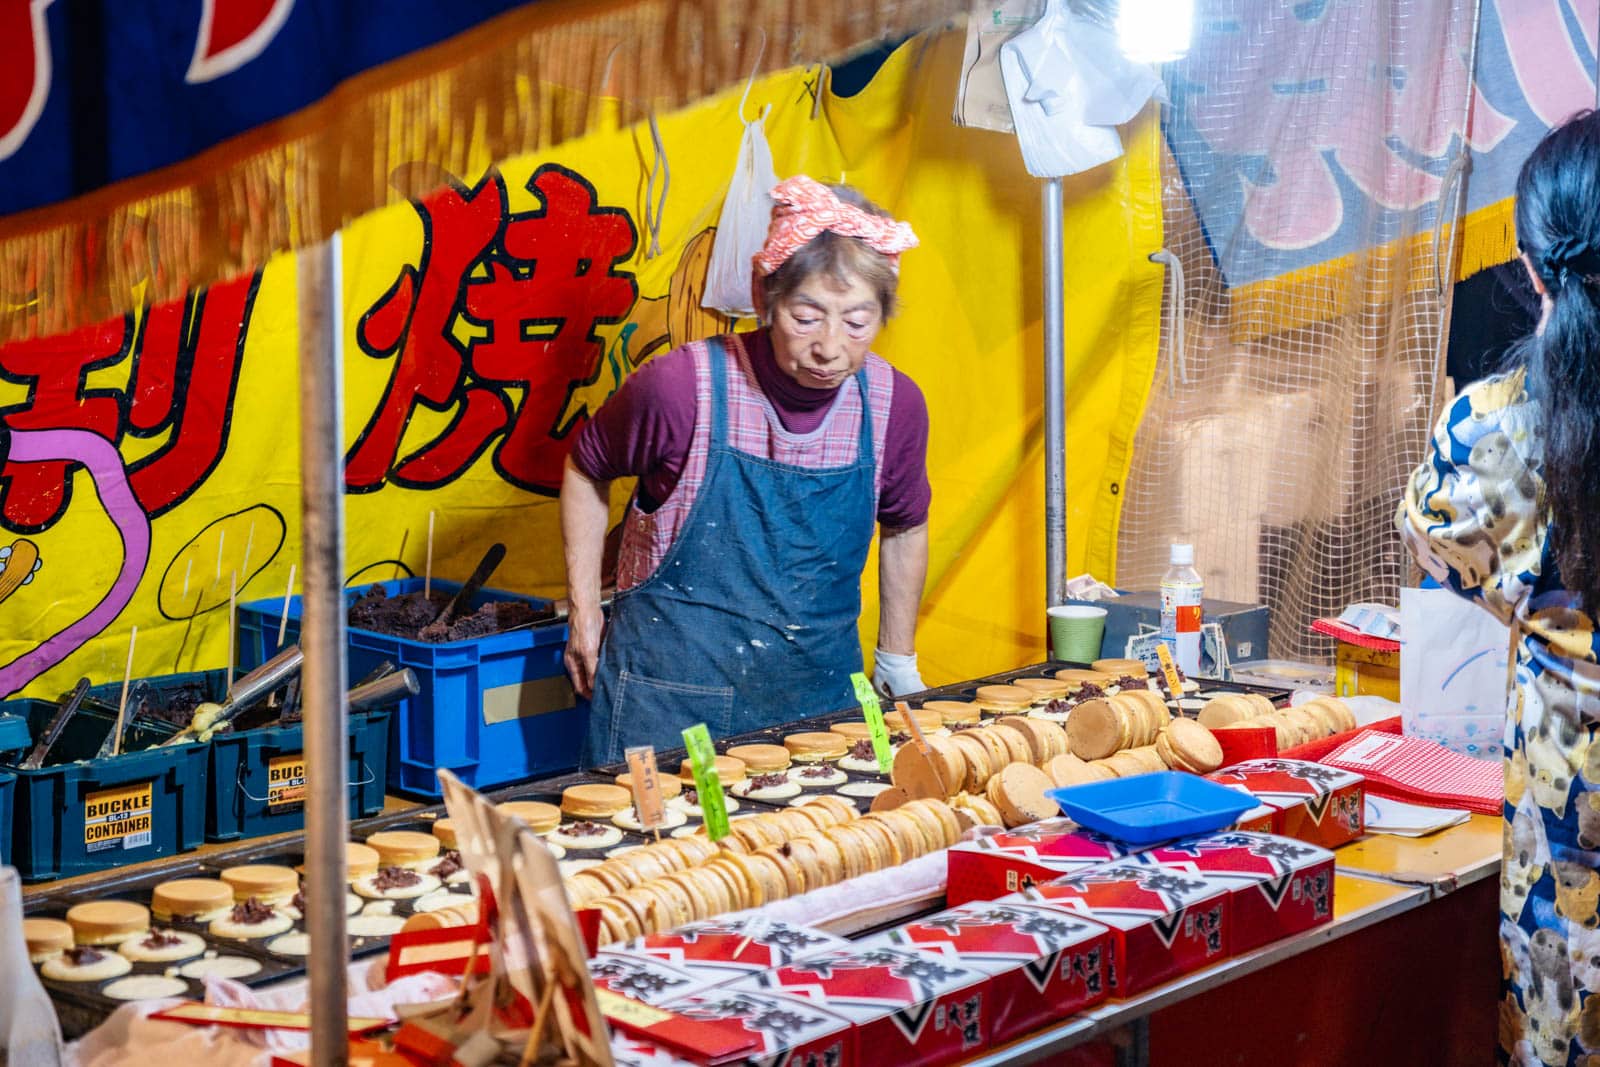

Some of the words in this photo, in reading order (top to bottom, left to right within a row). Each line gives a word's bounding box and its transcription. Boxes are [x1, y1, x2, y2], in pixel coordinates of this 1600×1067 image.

[271, 766, 304, 780] BUC
[87, 795, 149, 817] BUCKLE
[108, 813, 128, 821] BL-13
[86, 817, 149, 840] CONTAINER
